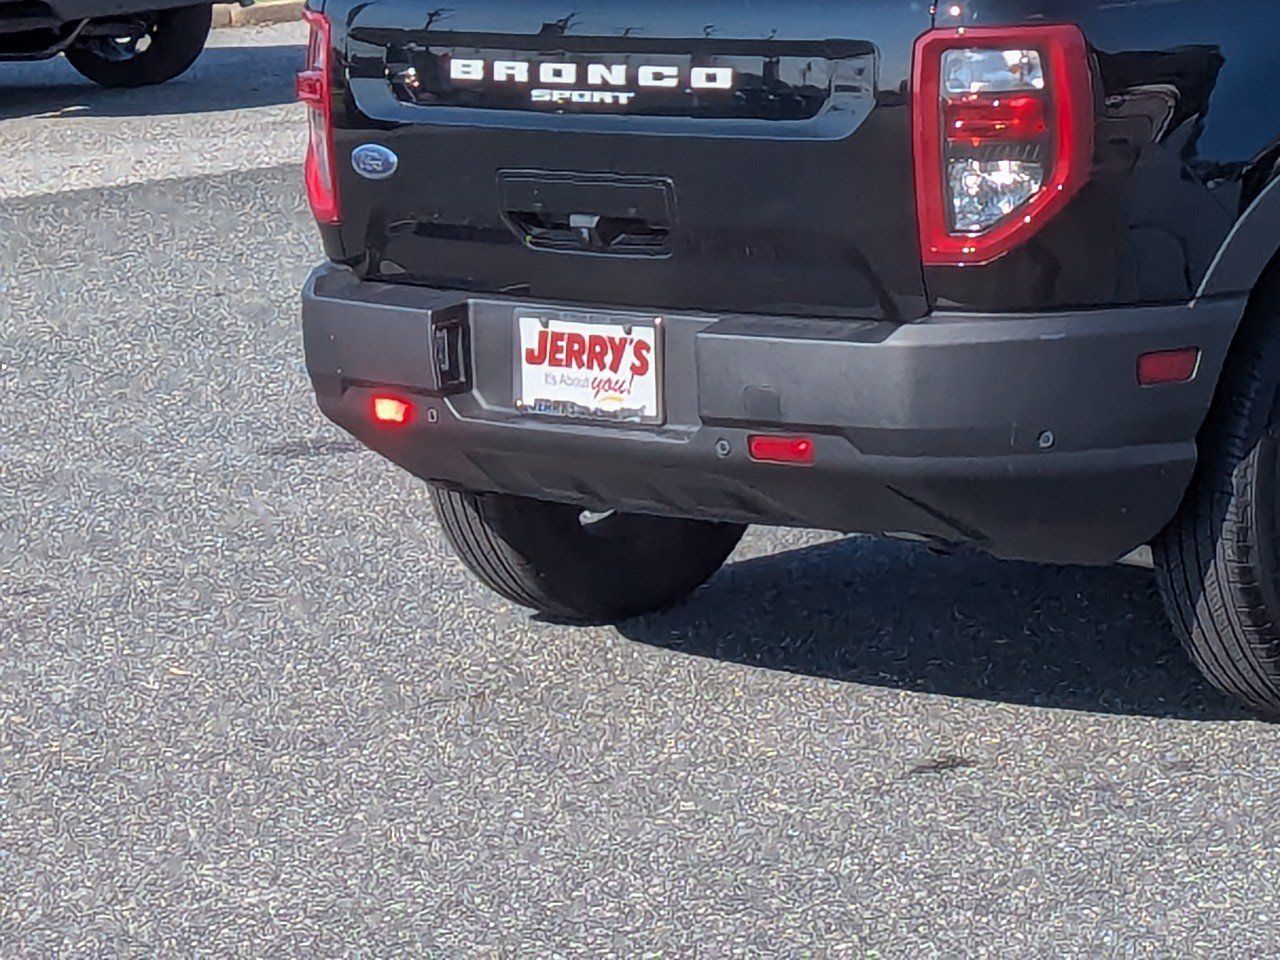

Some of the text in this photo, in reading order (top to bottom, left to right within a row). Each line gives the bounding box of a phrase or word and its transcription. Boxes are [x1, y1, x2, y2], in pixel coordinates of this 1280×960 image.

[449, 58, 734, 89] BRONCO
[530, 88, 636, 105] SPORT
[525, 329, 651, 377] JERRY'S
